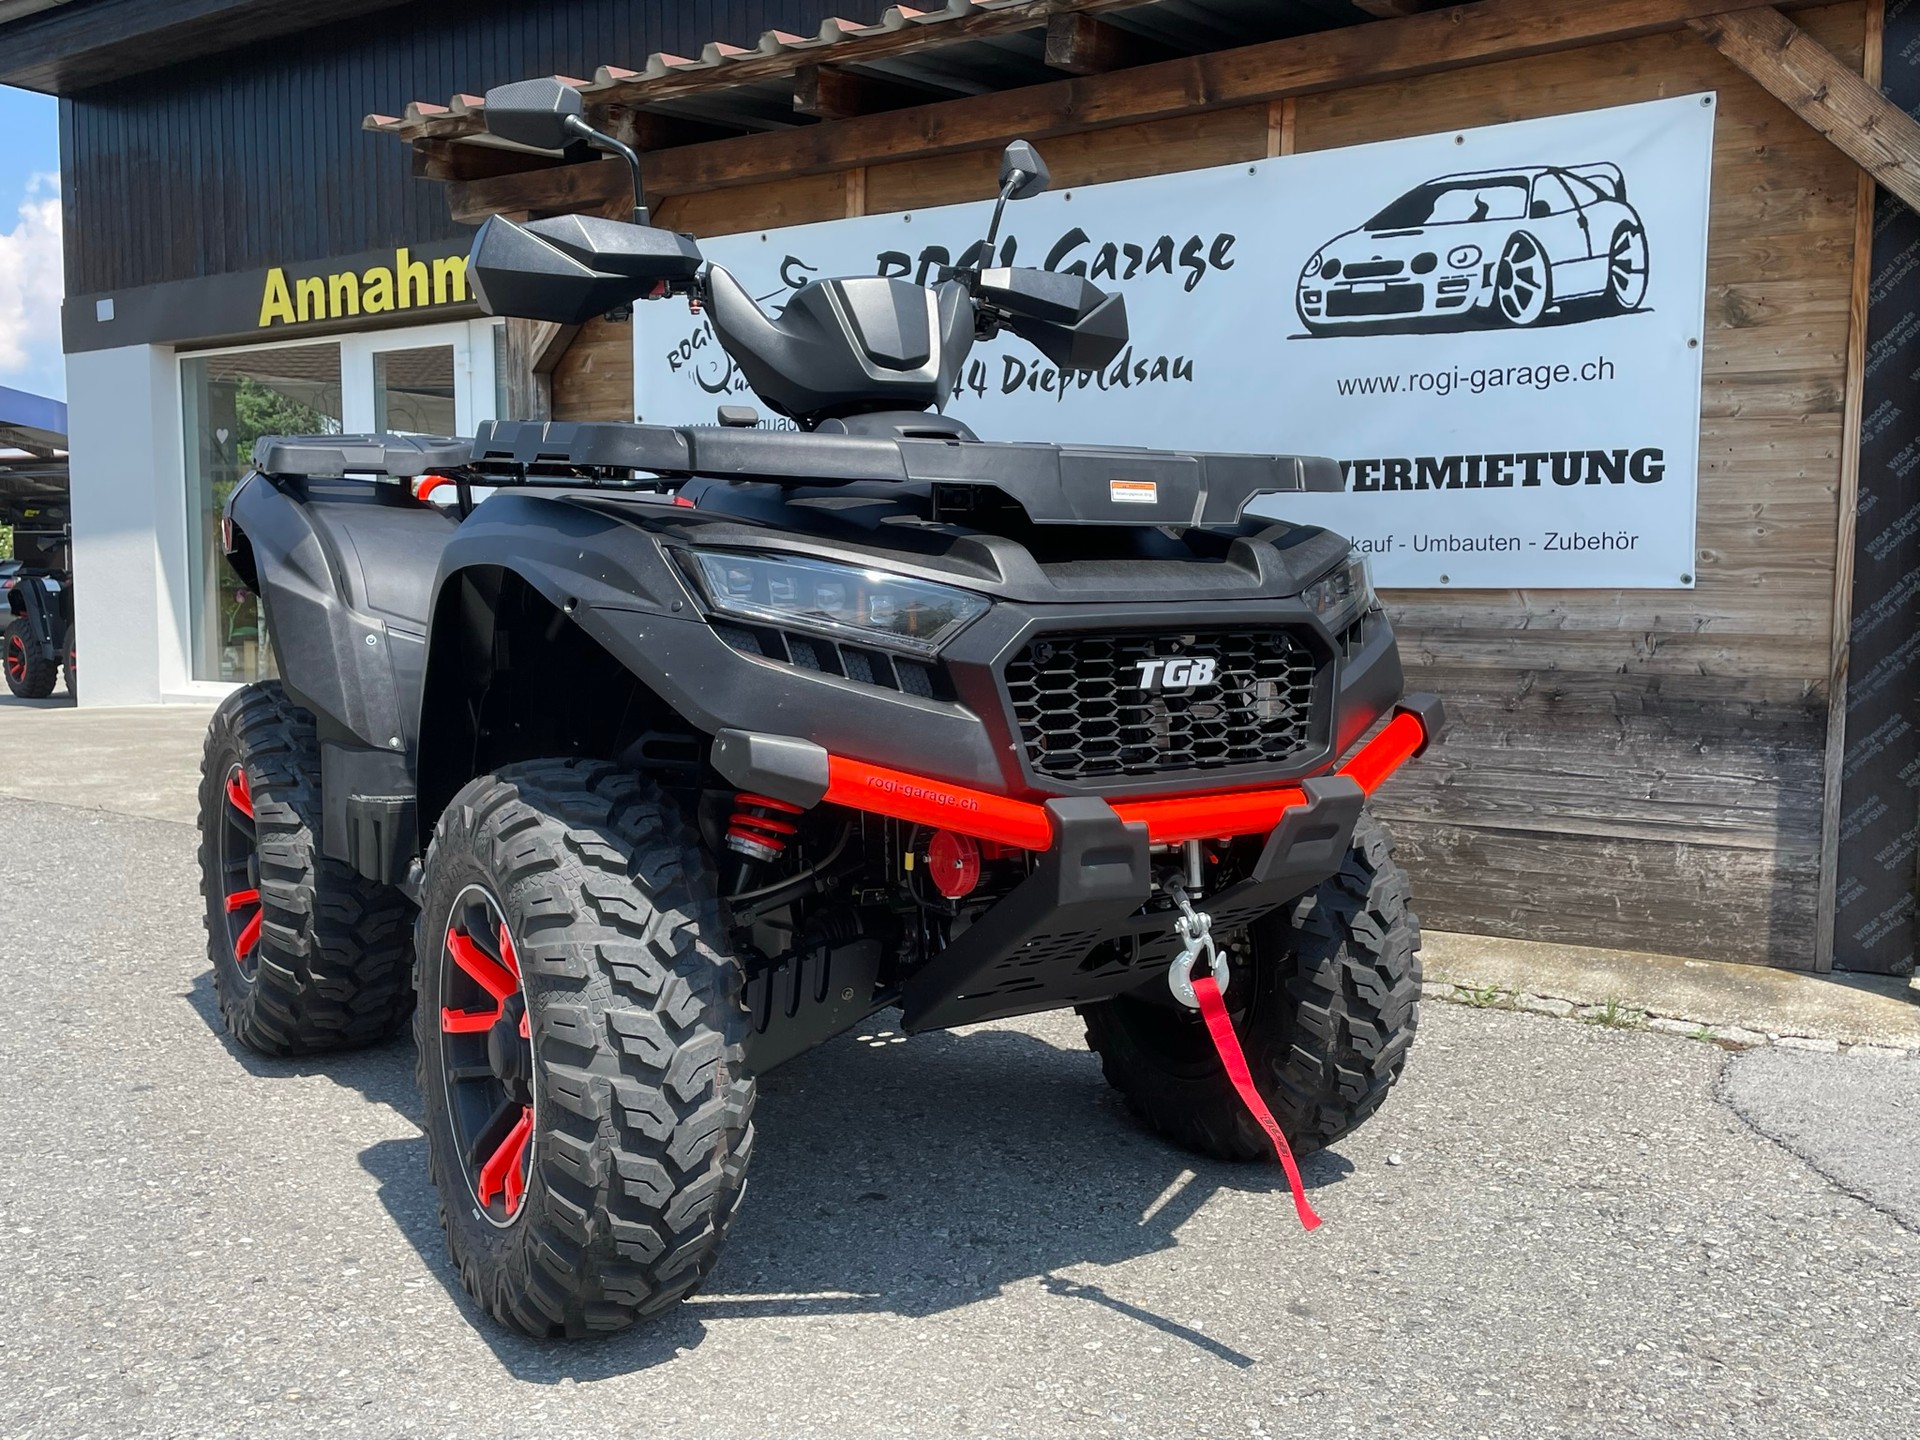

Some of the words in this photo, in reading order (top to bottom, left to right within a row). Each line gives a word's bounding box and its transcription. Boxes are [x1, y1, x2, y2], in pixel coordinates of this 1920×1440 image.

[666, 320, 713, 373] ROGI
[1871, 311, 1916, 353] Plywoods
[1337, 356, 1614, 396] www.rogi-garage.ch
[1351, 535, 1393, 553] kauf
[1414, 534, 1520, 553] Umbauten
[1543, 531, 1639, 551] Zubehör
[1136, 656, 1216, 690] TGB
[868, 777, 978, 811] rogi-garage.ch
